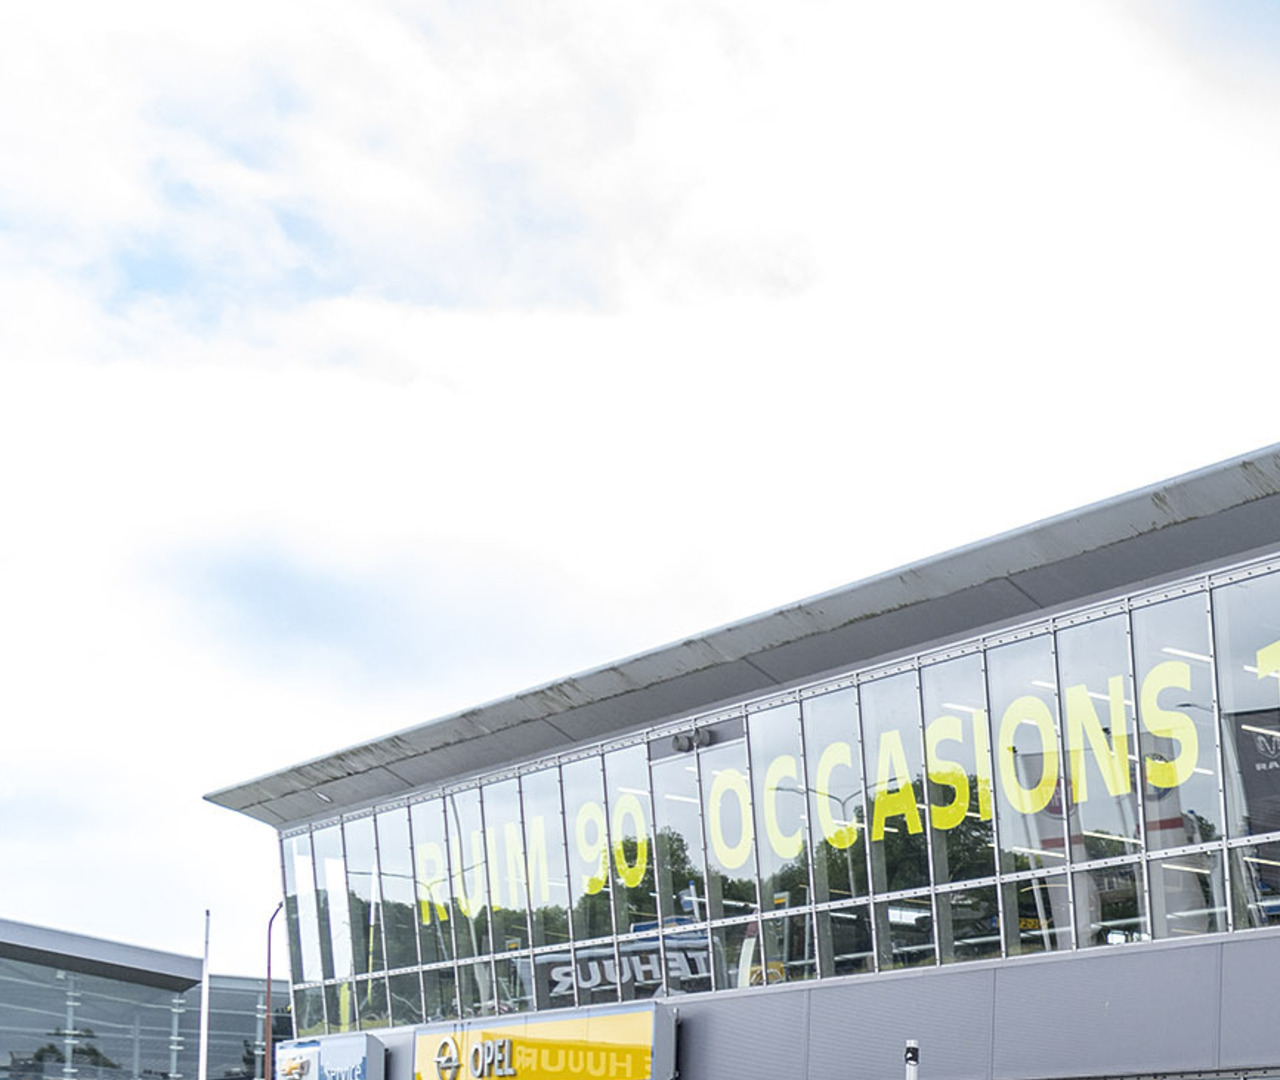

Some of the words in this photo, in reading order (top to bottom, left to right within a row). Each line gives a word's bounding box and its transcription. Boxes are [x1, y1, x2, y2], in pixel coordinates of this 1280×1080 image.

[417, 816, 549, 926] RUIM
[575, 794, 648, 895] 90
[709, 660, 1198, 869] OCCASIONS
[470, 1039, 516, 1078] OPEL
